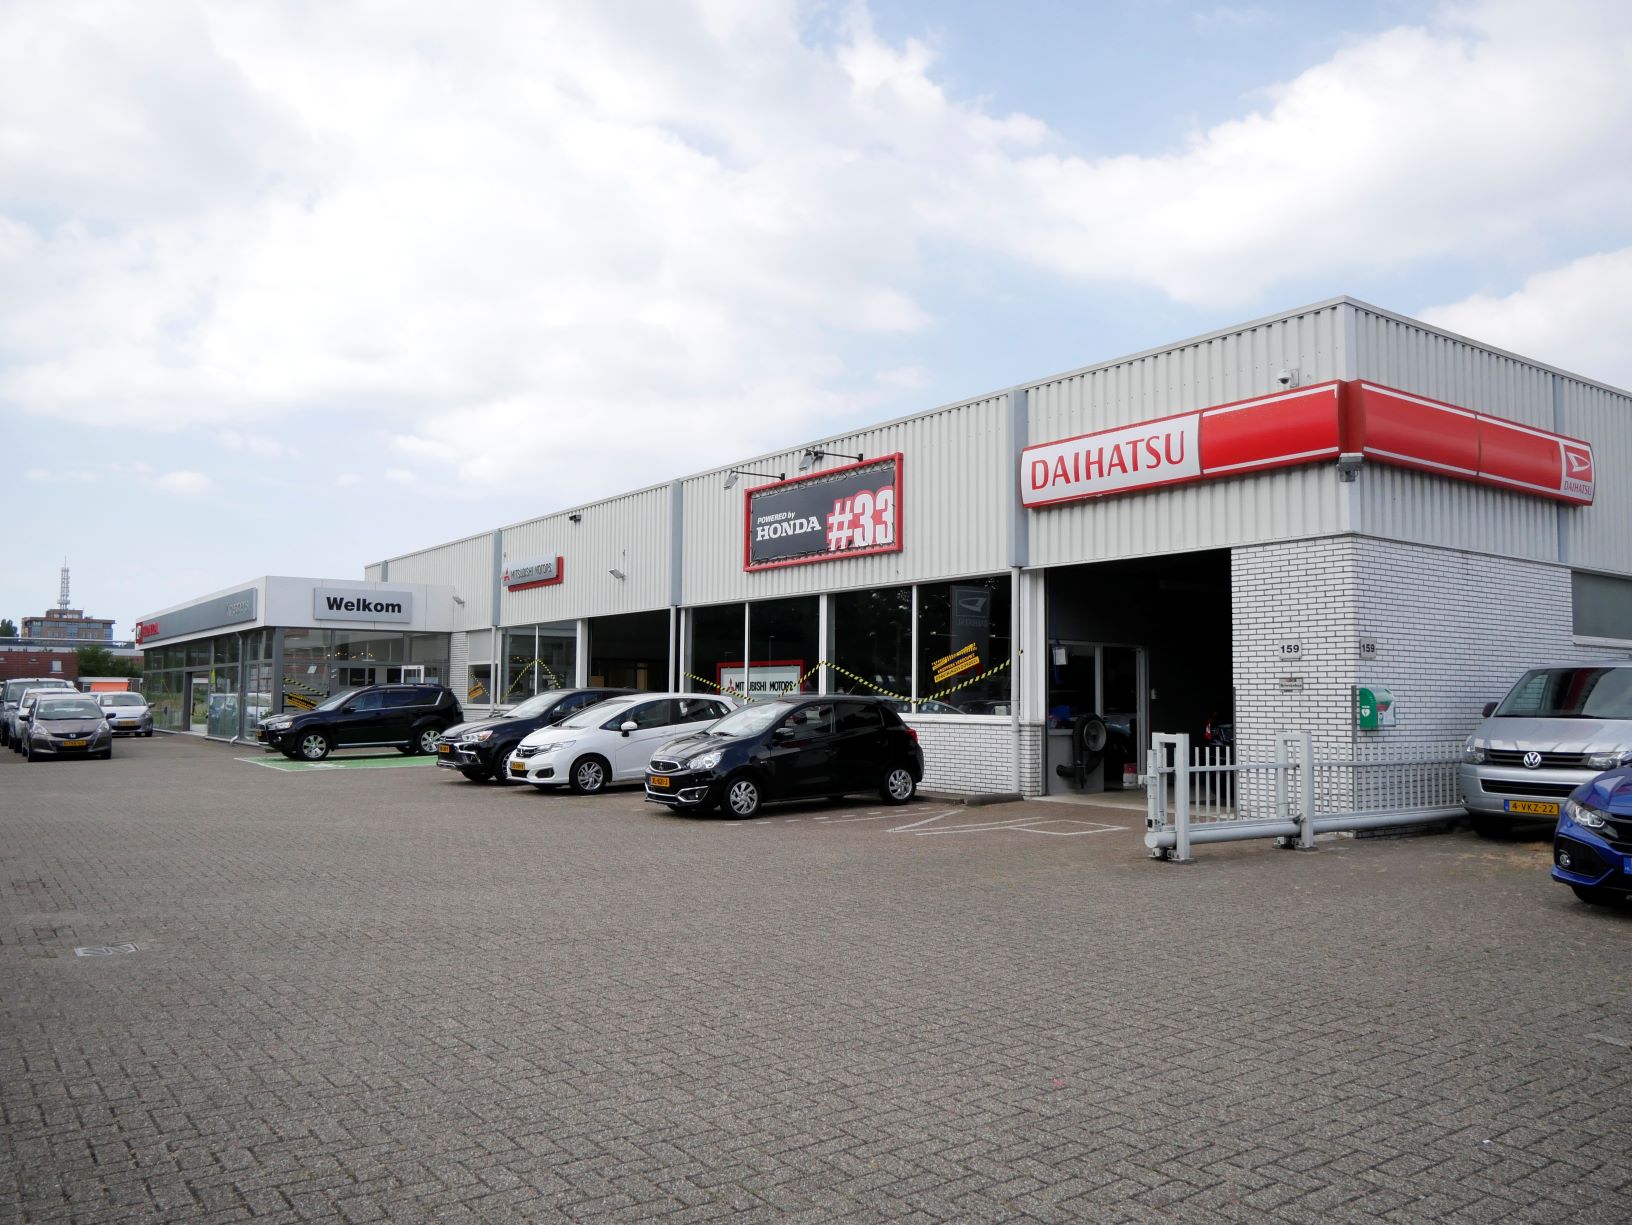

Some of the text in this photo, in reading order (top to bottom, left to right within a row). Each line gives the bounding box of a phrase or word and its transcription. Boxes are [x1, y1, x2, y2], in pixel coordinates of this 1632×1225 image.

[1031, 430, 1185, 491] DAIHATSU
[1564, 480, 1592, 496] DAIHATSU
[757, 511, 796, 524] POWERED by
[828, 489, 894, 551] #33
[756, 516, 822, 541] HONDA
[326, 596, 402, 613] Welkom
[1280, 644, 1300, 653] 159
[1362, 643, 1375, 653] 159
[735, 681, 767, 692] MITUBISHI
[1511, 803, 1555, 813] 4-VKZ-22
